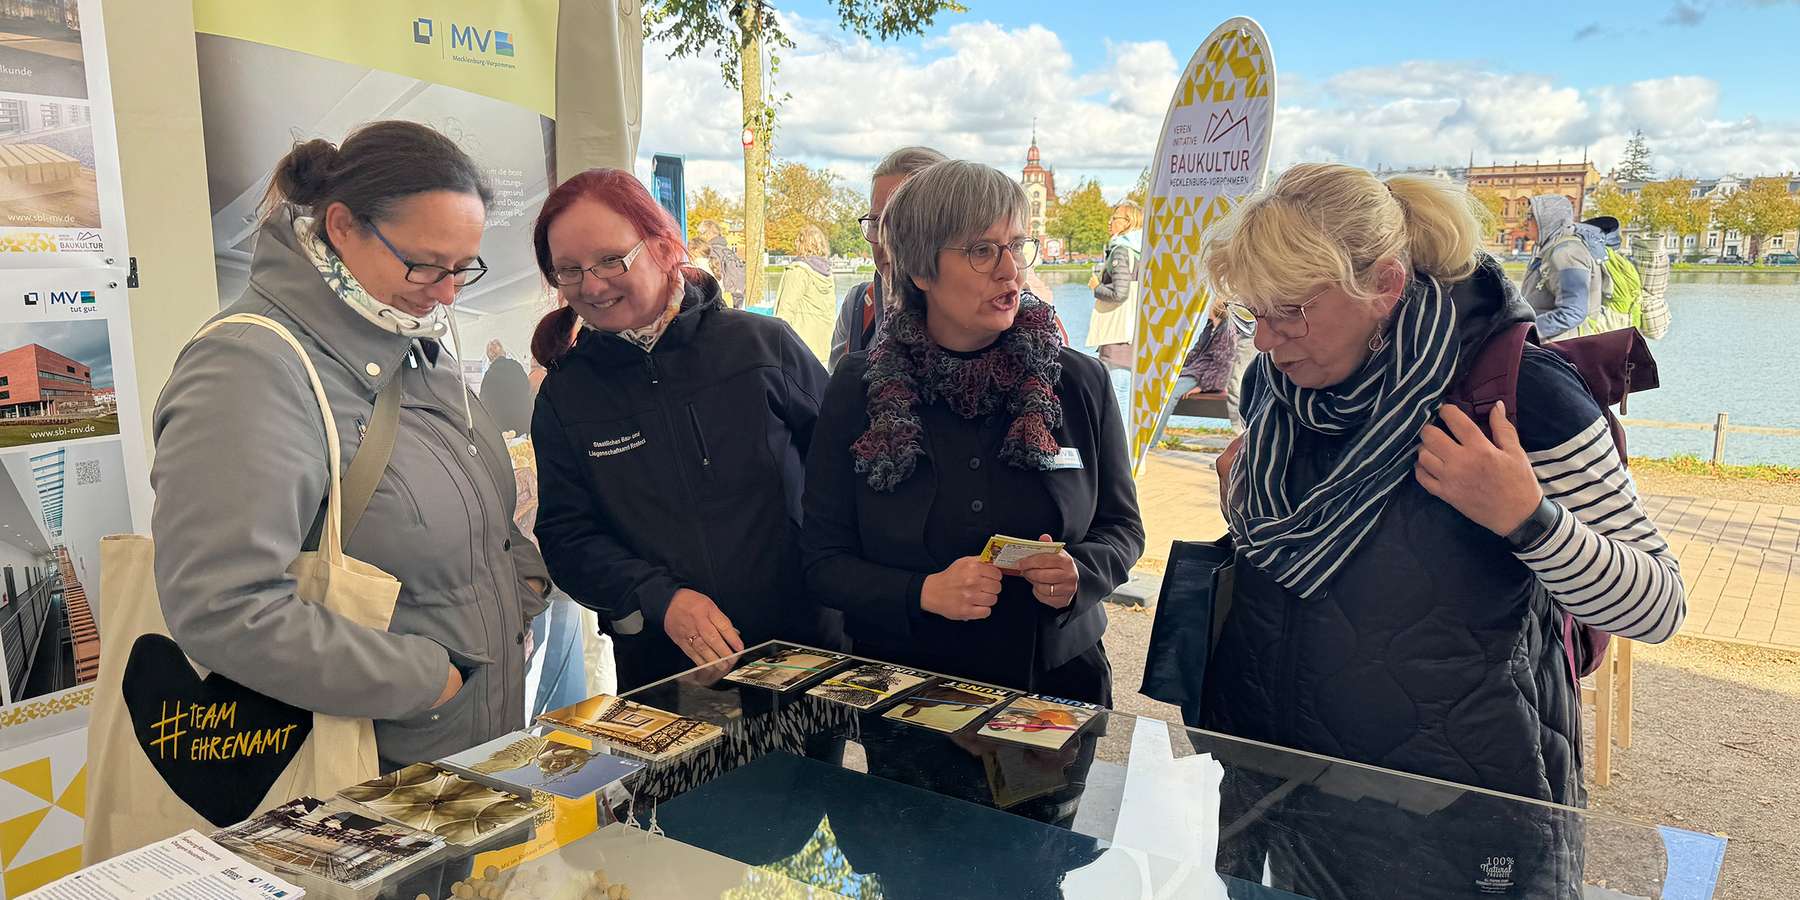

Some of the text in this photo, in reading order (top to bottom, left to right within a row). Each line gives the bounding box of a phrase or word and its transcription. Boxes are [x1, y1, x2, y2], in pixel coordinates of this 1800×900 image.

[451, 23, 492, 52] MV
[1174, 125, 1192, 135] VEREIN
[1173, 136, 1198, 146] INITIATIVE
[1170, 150, 1250, 174] BAUKULTUR
[1169, 176, 1250, 188] MECKLENBURG-VORPOMMERN
[7, 213, 76, 223] www.sbl-mv.de
[50, 291, 78, 305] MV
[30, 424, 96, 439] www.sbl-mv.de
[632, 431, 640, 439] und
[589, 445, 631, 457] Liegenschaftsamt
[938, 681, 1008, 697] KUNST
[1027, 692, 1105, 710] KUNST
[191, 724, 298, 761] EHRENAMT
[1487, 857, 1515, 865] 100%
[1480, 864, 1513, 874] Natural
